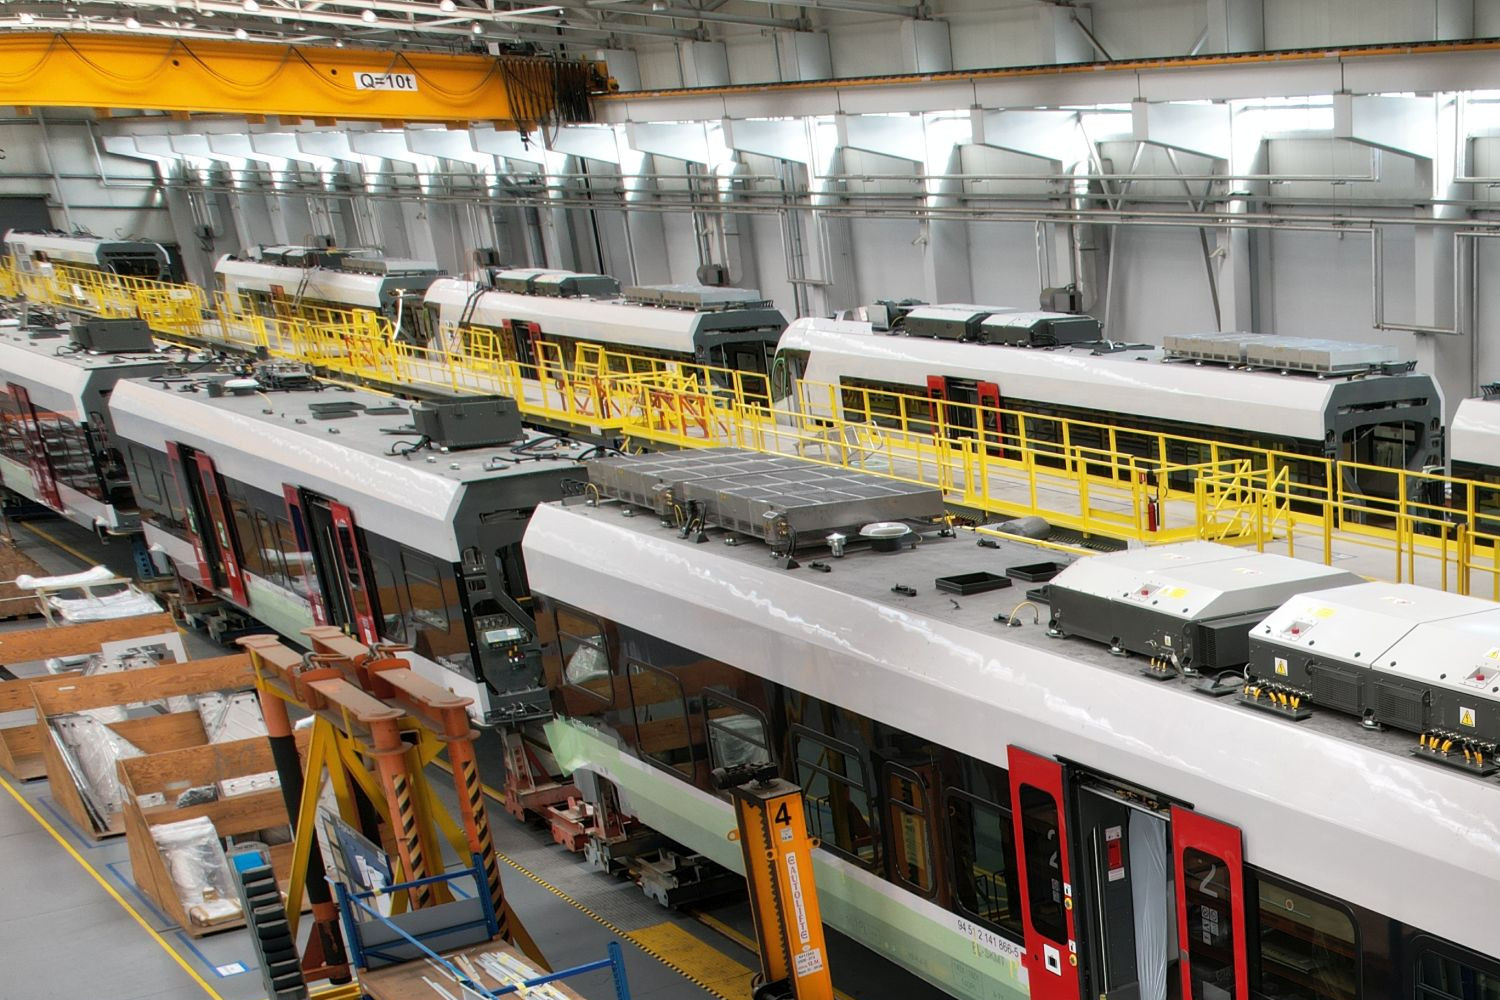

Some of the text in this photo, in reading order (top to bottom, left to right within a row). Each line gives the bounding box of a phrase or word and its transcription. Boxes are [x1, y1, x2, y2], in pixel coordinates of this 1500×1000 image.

[360, 73, 413, 89] Q=10t
[774, 802, 792, 827] 4
[977, 929, 983, 941] 2
[984, 933, 997, 947] 141
